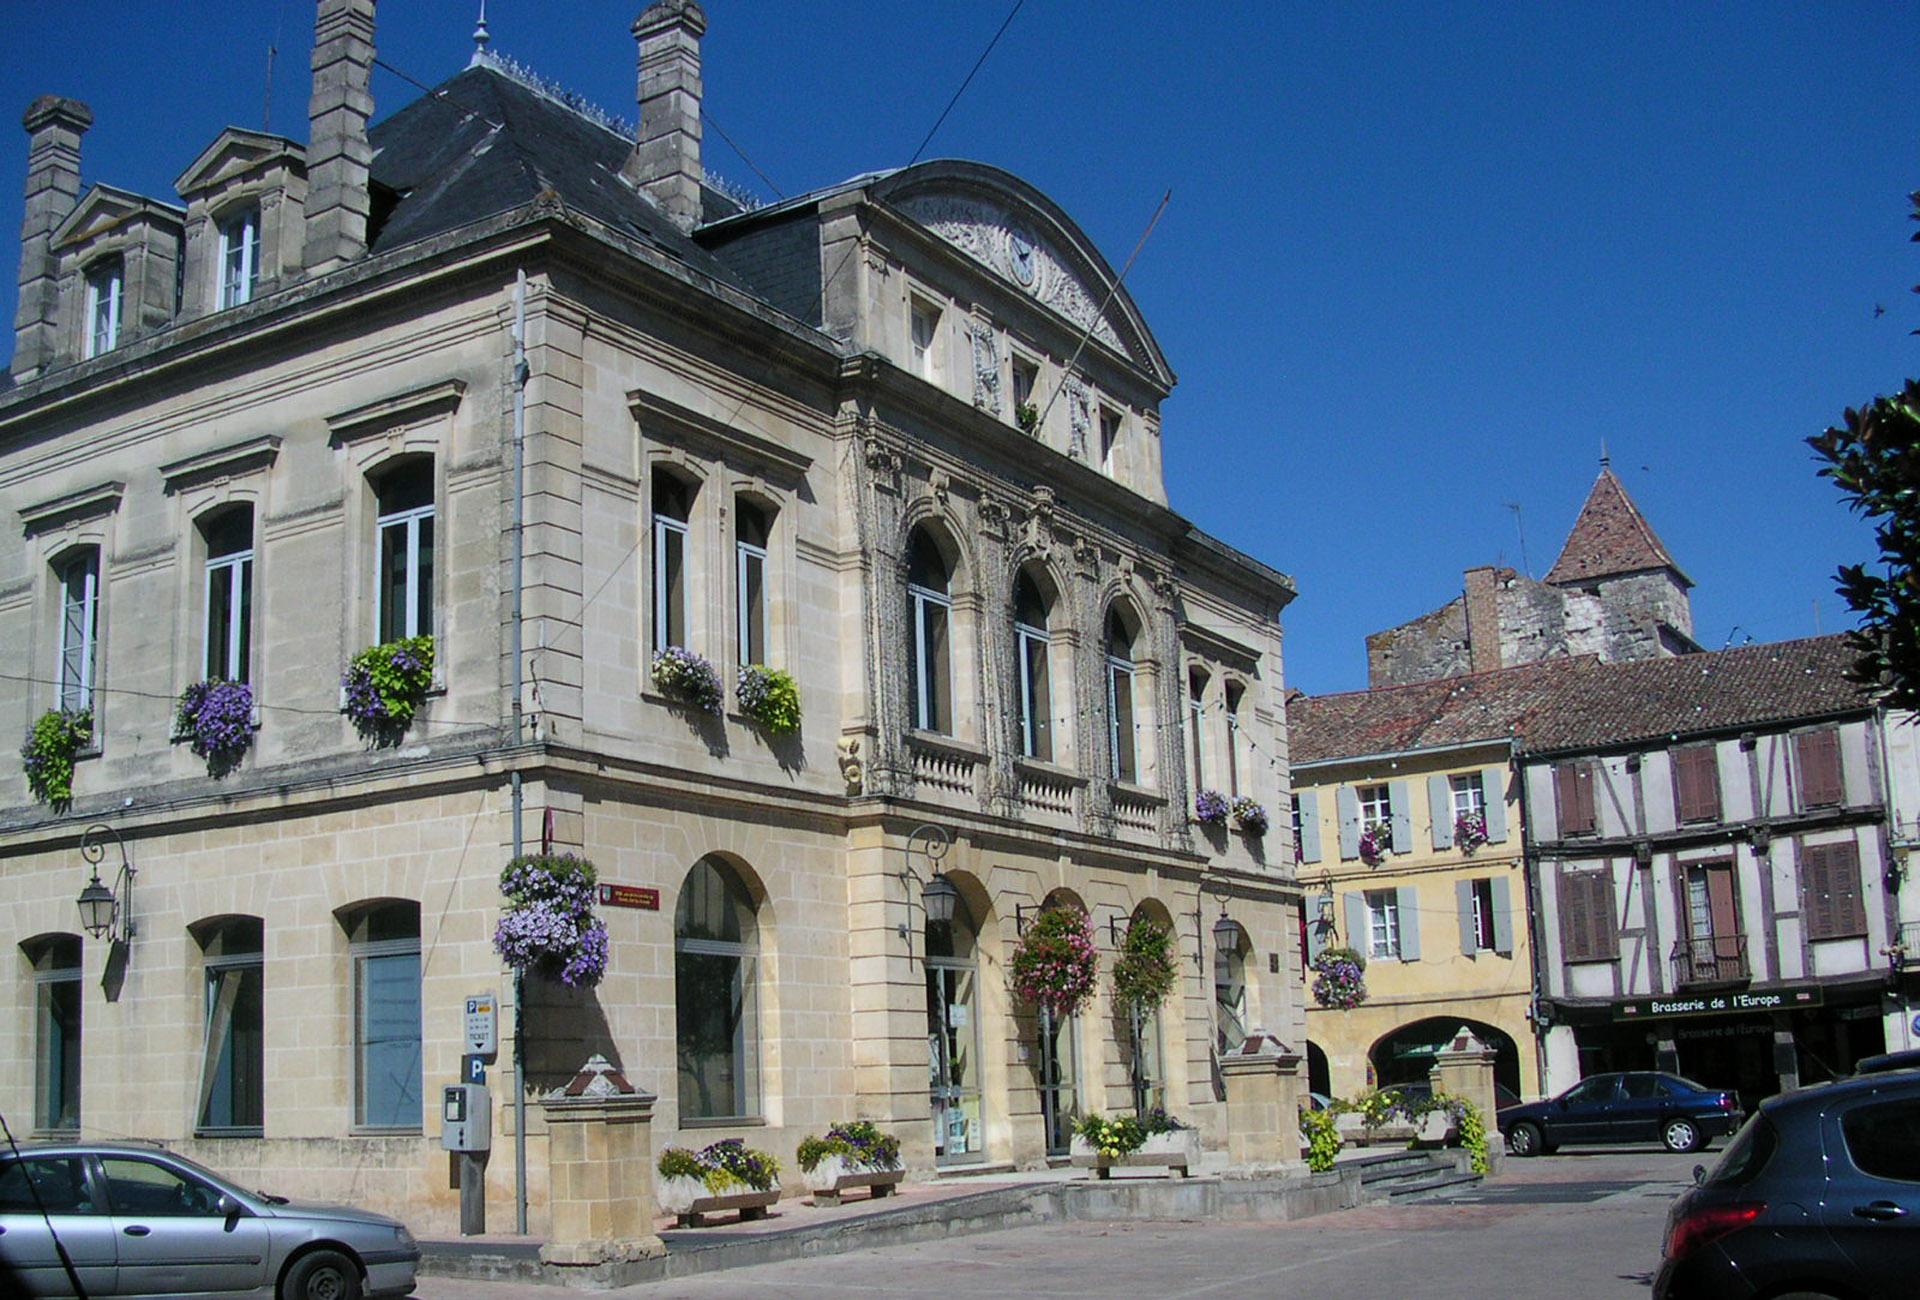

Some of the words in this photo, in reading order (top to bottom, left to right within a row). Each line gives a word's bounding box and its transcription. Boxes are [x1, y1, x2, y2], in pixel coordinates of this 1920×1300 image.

[1651, 999, 1705, 1013] Brasserie
[1710, 997, 1726, 1009] de
[1733, 994, 1781, 1008] l'Europe
[469, 1032, 489, 1041] TICKET
[472, 1060, 482, 1078] P
